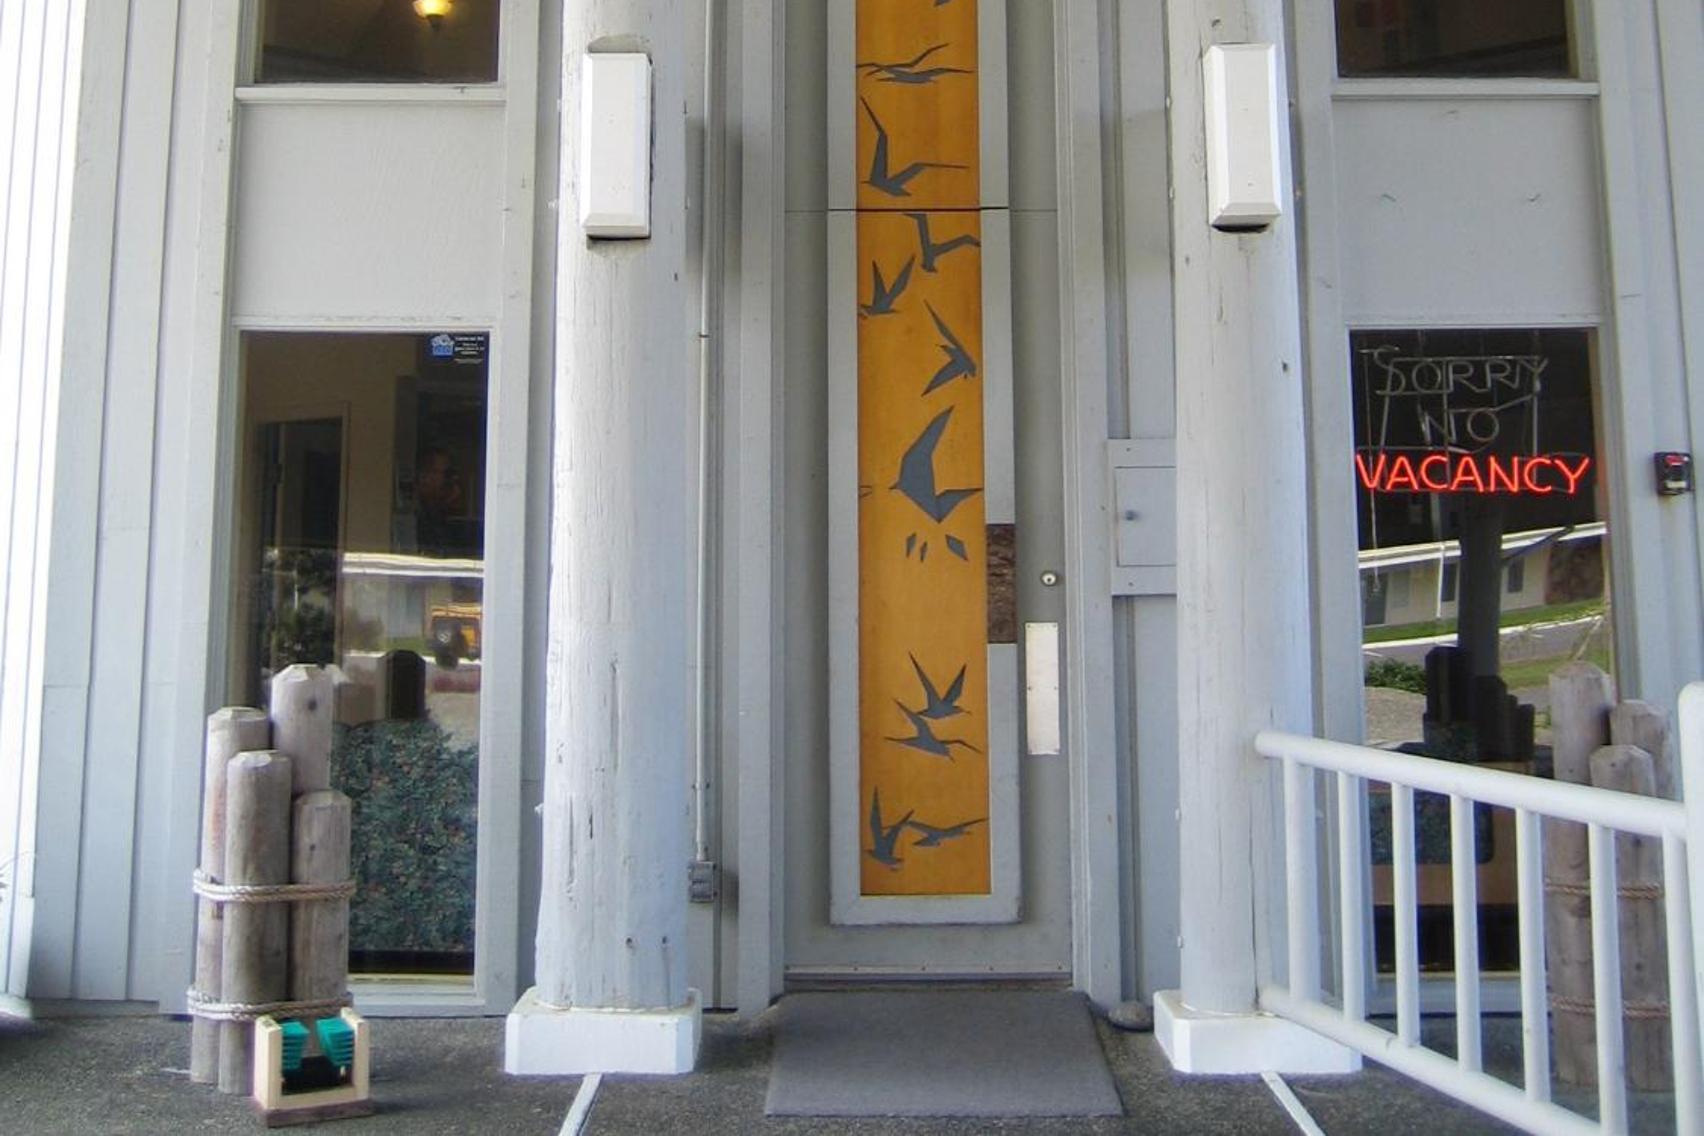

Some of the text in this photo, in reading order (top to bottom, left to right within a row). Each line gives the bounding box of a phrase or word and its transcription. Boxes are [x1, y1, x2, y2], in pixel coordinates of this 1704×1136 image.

[1372, 346, 1549, 394] SORRY
[1420, 409, 1500, 443] NO
[1355, 452, 1591, 494] VACANCY
